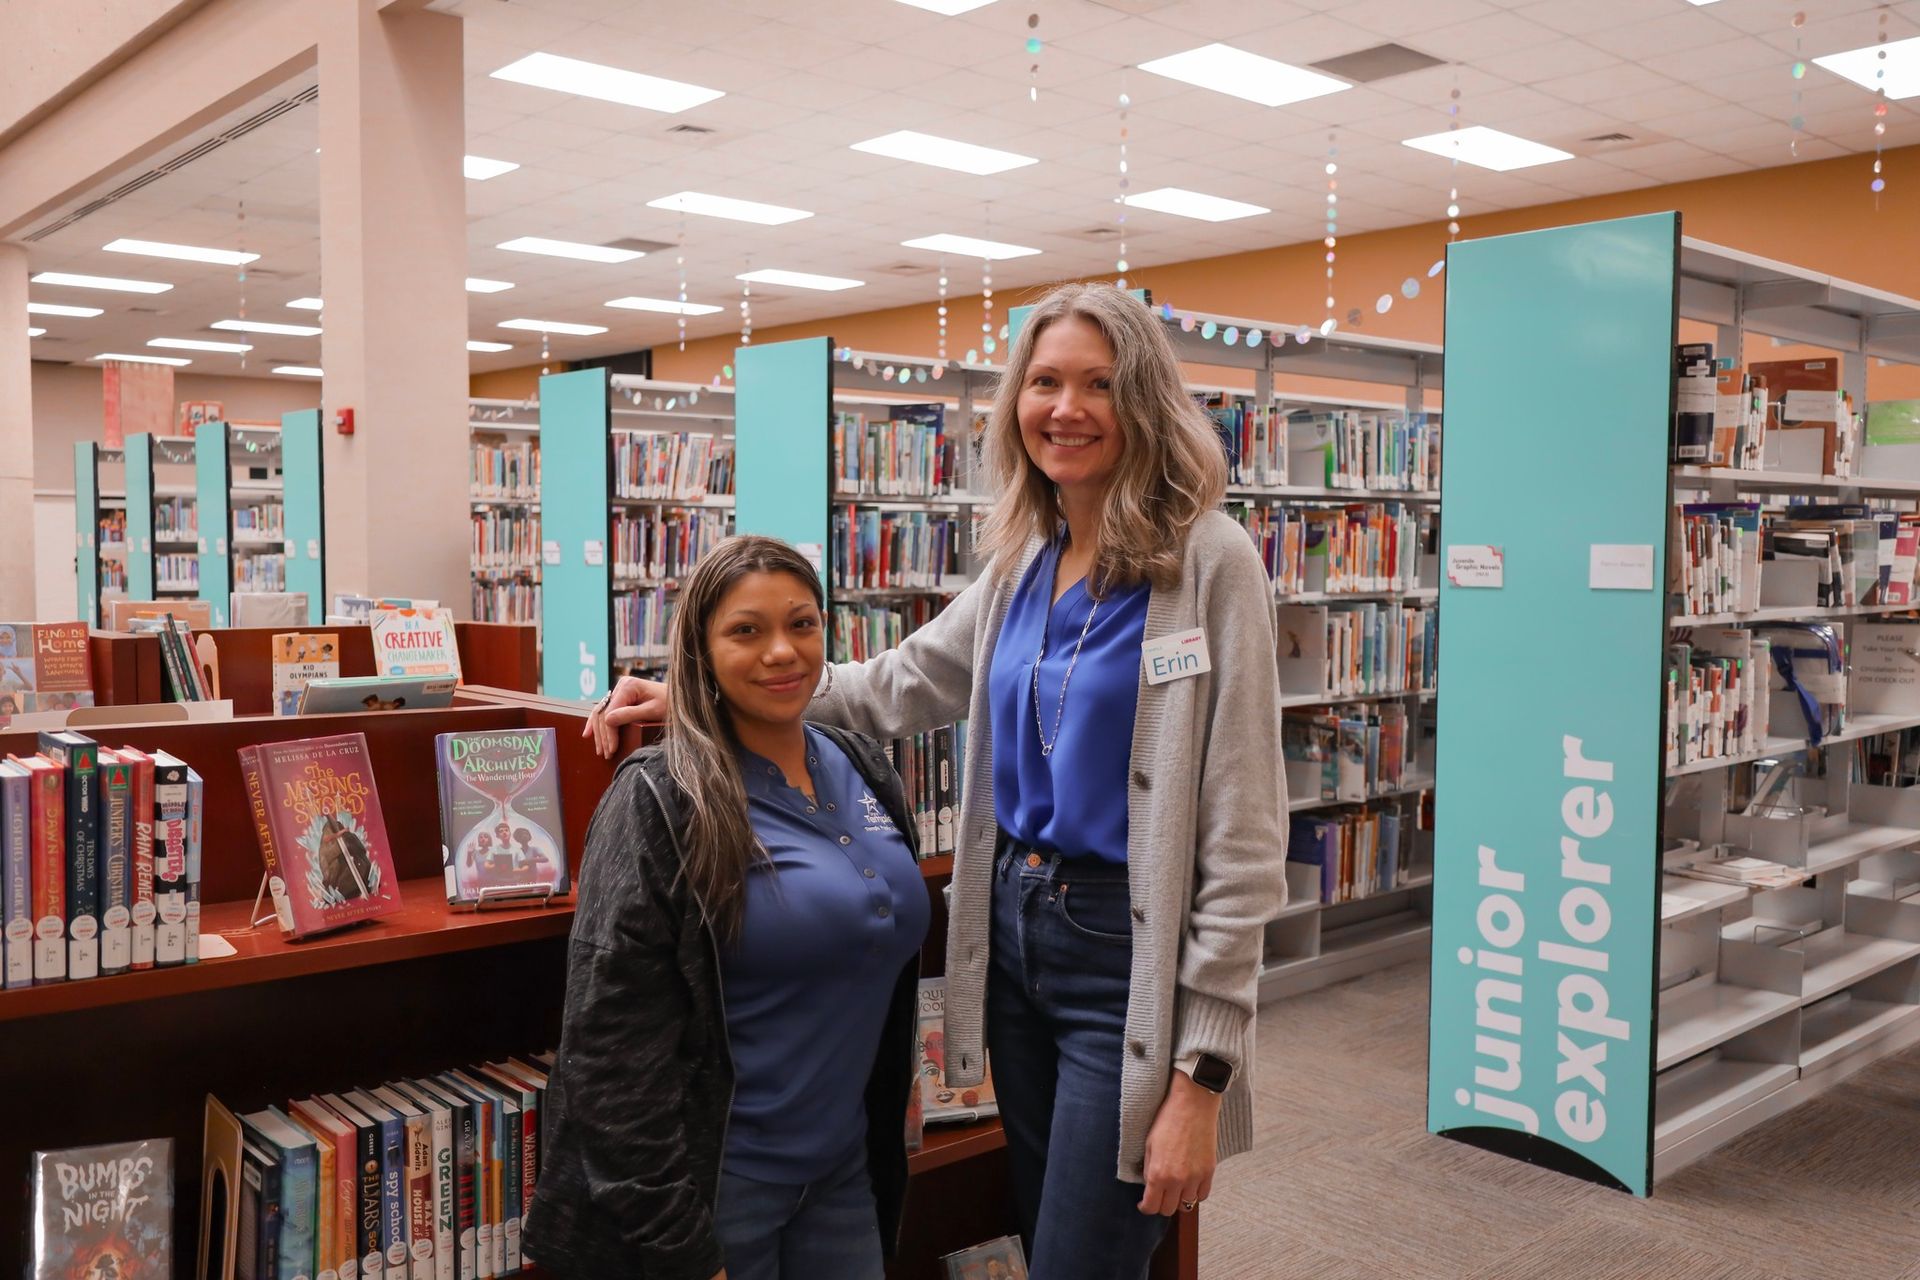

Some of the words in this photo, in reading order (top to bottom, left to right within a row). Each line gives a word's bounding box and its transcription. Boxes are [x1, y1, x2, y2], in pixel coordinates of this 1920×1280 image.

[385, 630, 443, 649] CREATIVE
[1181, 636, 1201, 645] LIBRARY
[387, 648, 447, 664] CHANGEMAKER
[1152, 650, 1199, 677] Erin
[289, 671, 328, 679] OLYMPIANS
[274, 753, 310, 764] MELISSA
[312, 751, 324, 759] DE
[325, 749, 337, 757] LA
[339, 746, 360, 756] CRUZ
[452, 735, 544, 761] DOOMSDAY
[304, 760, 335, 779] The
[463, 753, 538, 773] ARCHIVES
[466, 774, 479, 782] The
[478, 771, 518, 783] Wandering
[518, 770, 537, 779] Hour
[283, 772, 369, 808] MISSING
[247, 770, 266, 819] NEVER
[257, 822, 276, 868] AFTER
[294, 793, 365, 825] SWORD
[47, 808, 59, 854] DAWN
[76, 831, 85, 843] OF
[136, 822, 153, 857] RAIN
[87, 839, 95, 858] TEN
[75, 843, 85, 891] CHRISTMAS
[87, 858, 95, 879] DAYS
[107, 853, 126, 906] CHRISTMA
[46, 887, 60, 915] JAG
[1538, 733, 1631, 1144] explorer
[1455, 844, 1540, 1135] junior
[463, 1119, 472, 1151] GRATZ
[525, 1132, 537, 1186] WARRIOR
[55, 1157, 154, 1203] BUMPS
[387, 1171, 399, 1198] spy
[438, 1147, 453, 1233] GREEN
[88, 1192, 98, 1200] IN
[99, 1190, 116, 1198] THE
[363, 1182, 381, 1230] LIARS
[413, 1189, 423, 1225] HOUSE
[62, 1194, 150, 1234] NIGHT
[390, 1200, 403, 1243] schoo
[424, 1200, 433, 1227] MAX
[413, 1227, 423, 1237] of
[424, 1229, 430, 1237] in
